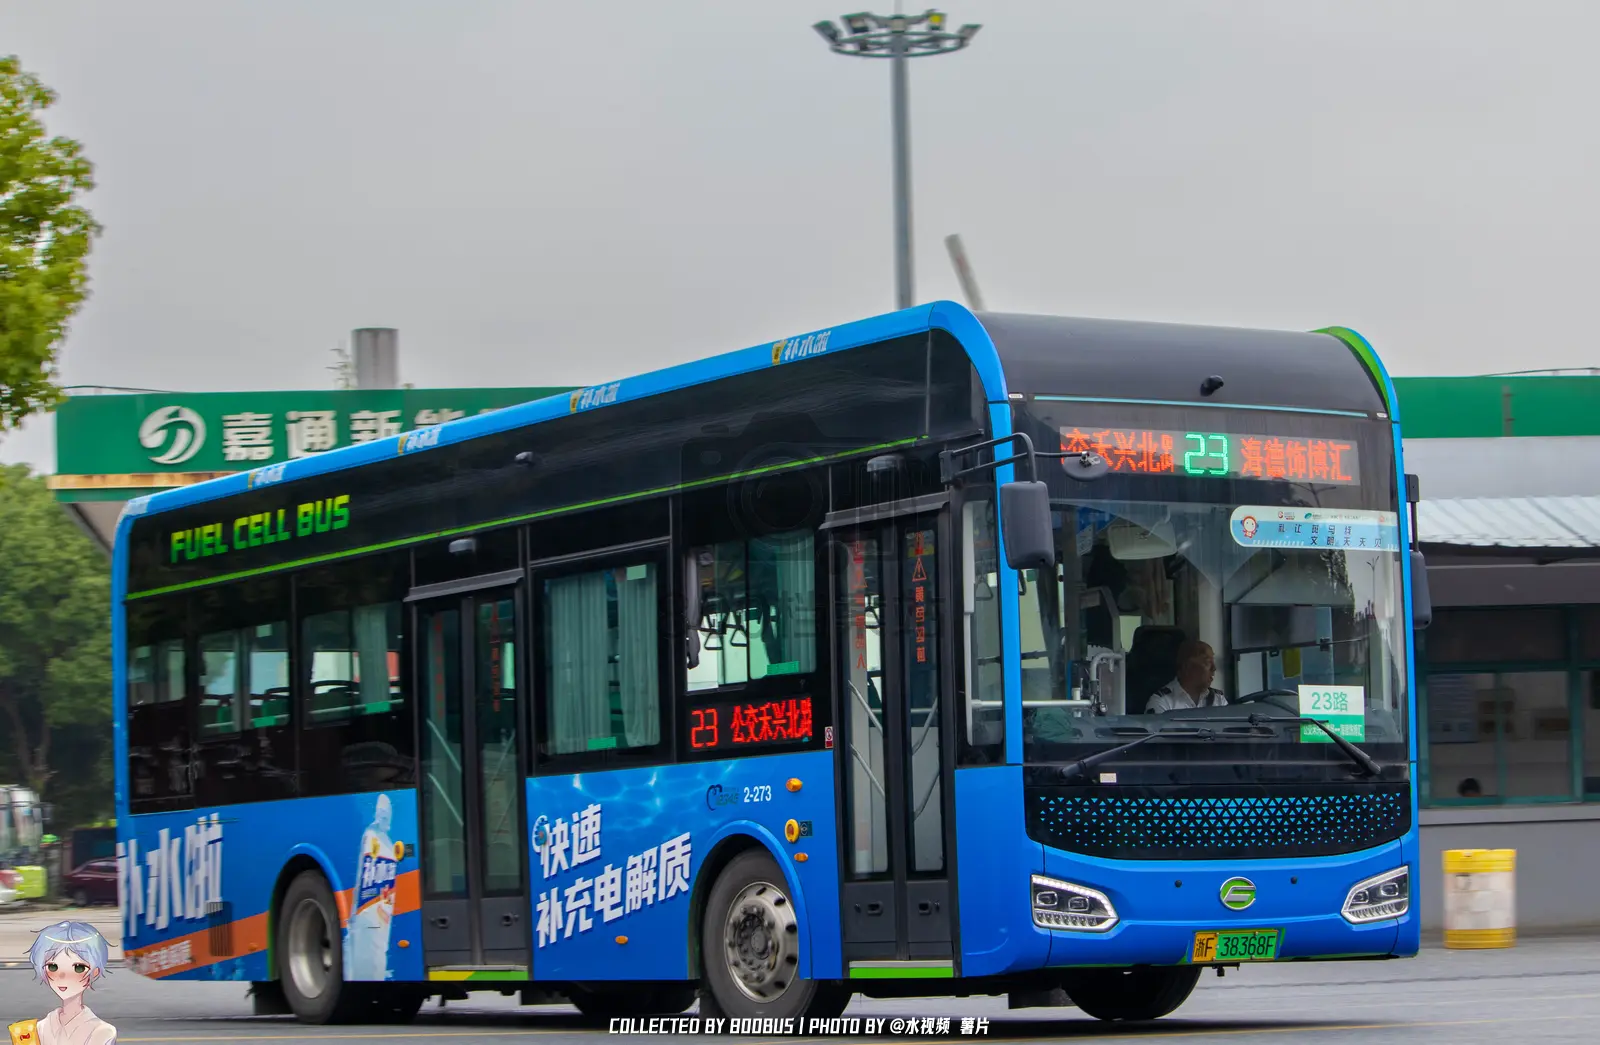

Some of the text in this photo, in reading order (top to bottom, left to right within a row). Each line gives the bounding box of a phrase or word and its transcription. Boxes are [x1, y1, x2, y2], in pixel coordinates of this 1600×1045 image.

[222, 408, 500, 461] 嘉通新
[1184, 433, 1229, 475] 23
[1240, 436, 1352, 481] 海德饰博汇
[171, 495, 350, 563] FUEL CELL BUS
[1311, 692, 1348, 711] 23路
[691, 708, 719, 748] 23
[743, 785, 772, 803] 2-273
[539, 803, 602, 879] 快速
[536, 832, 691, 948] 补充电解质
